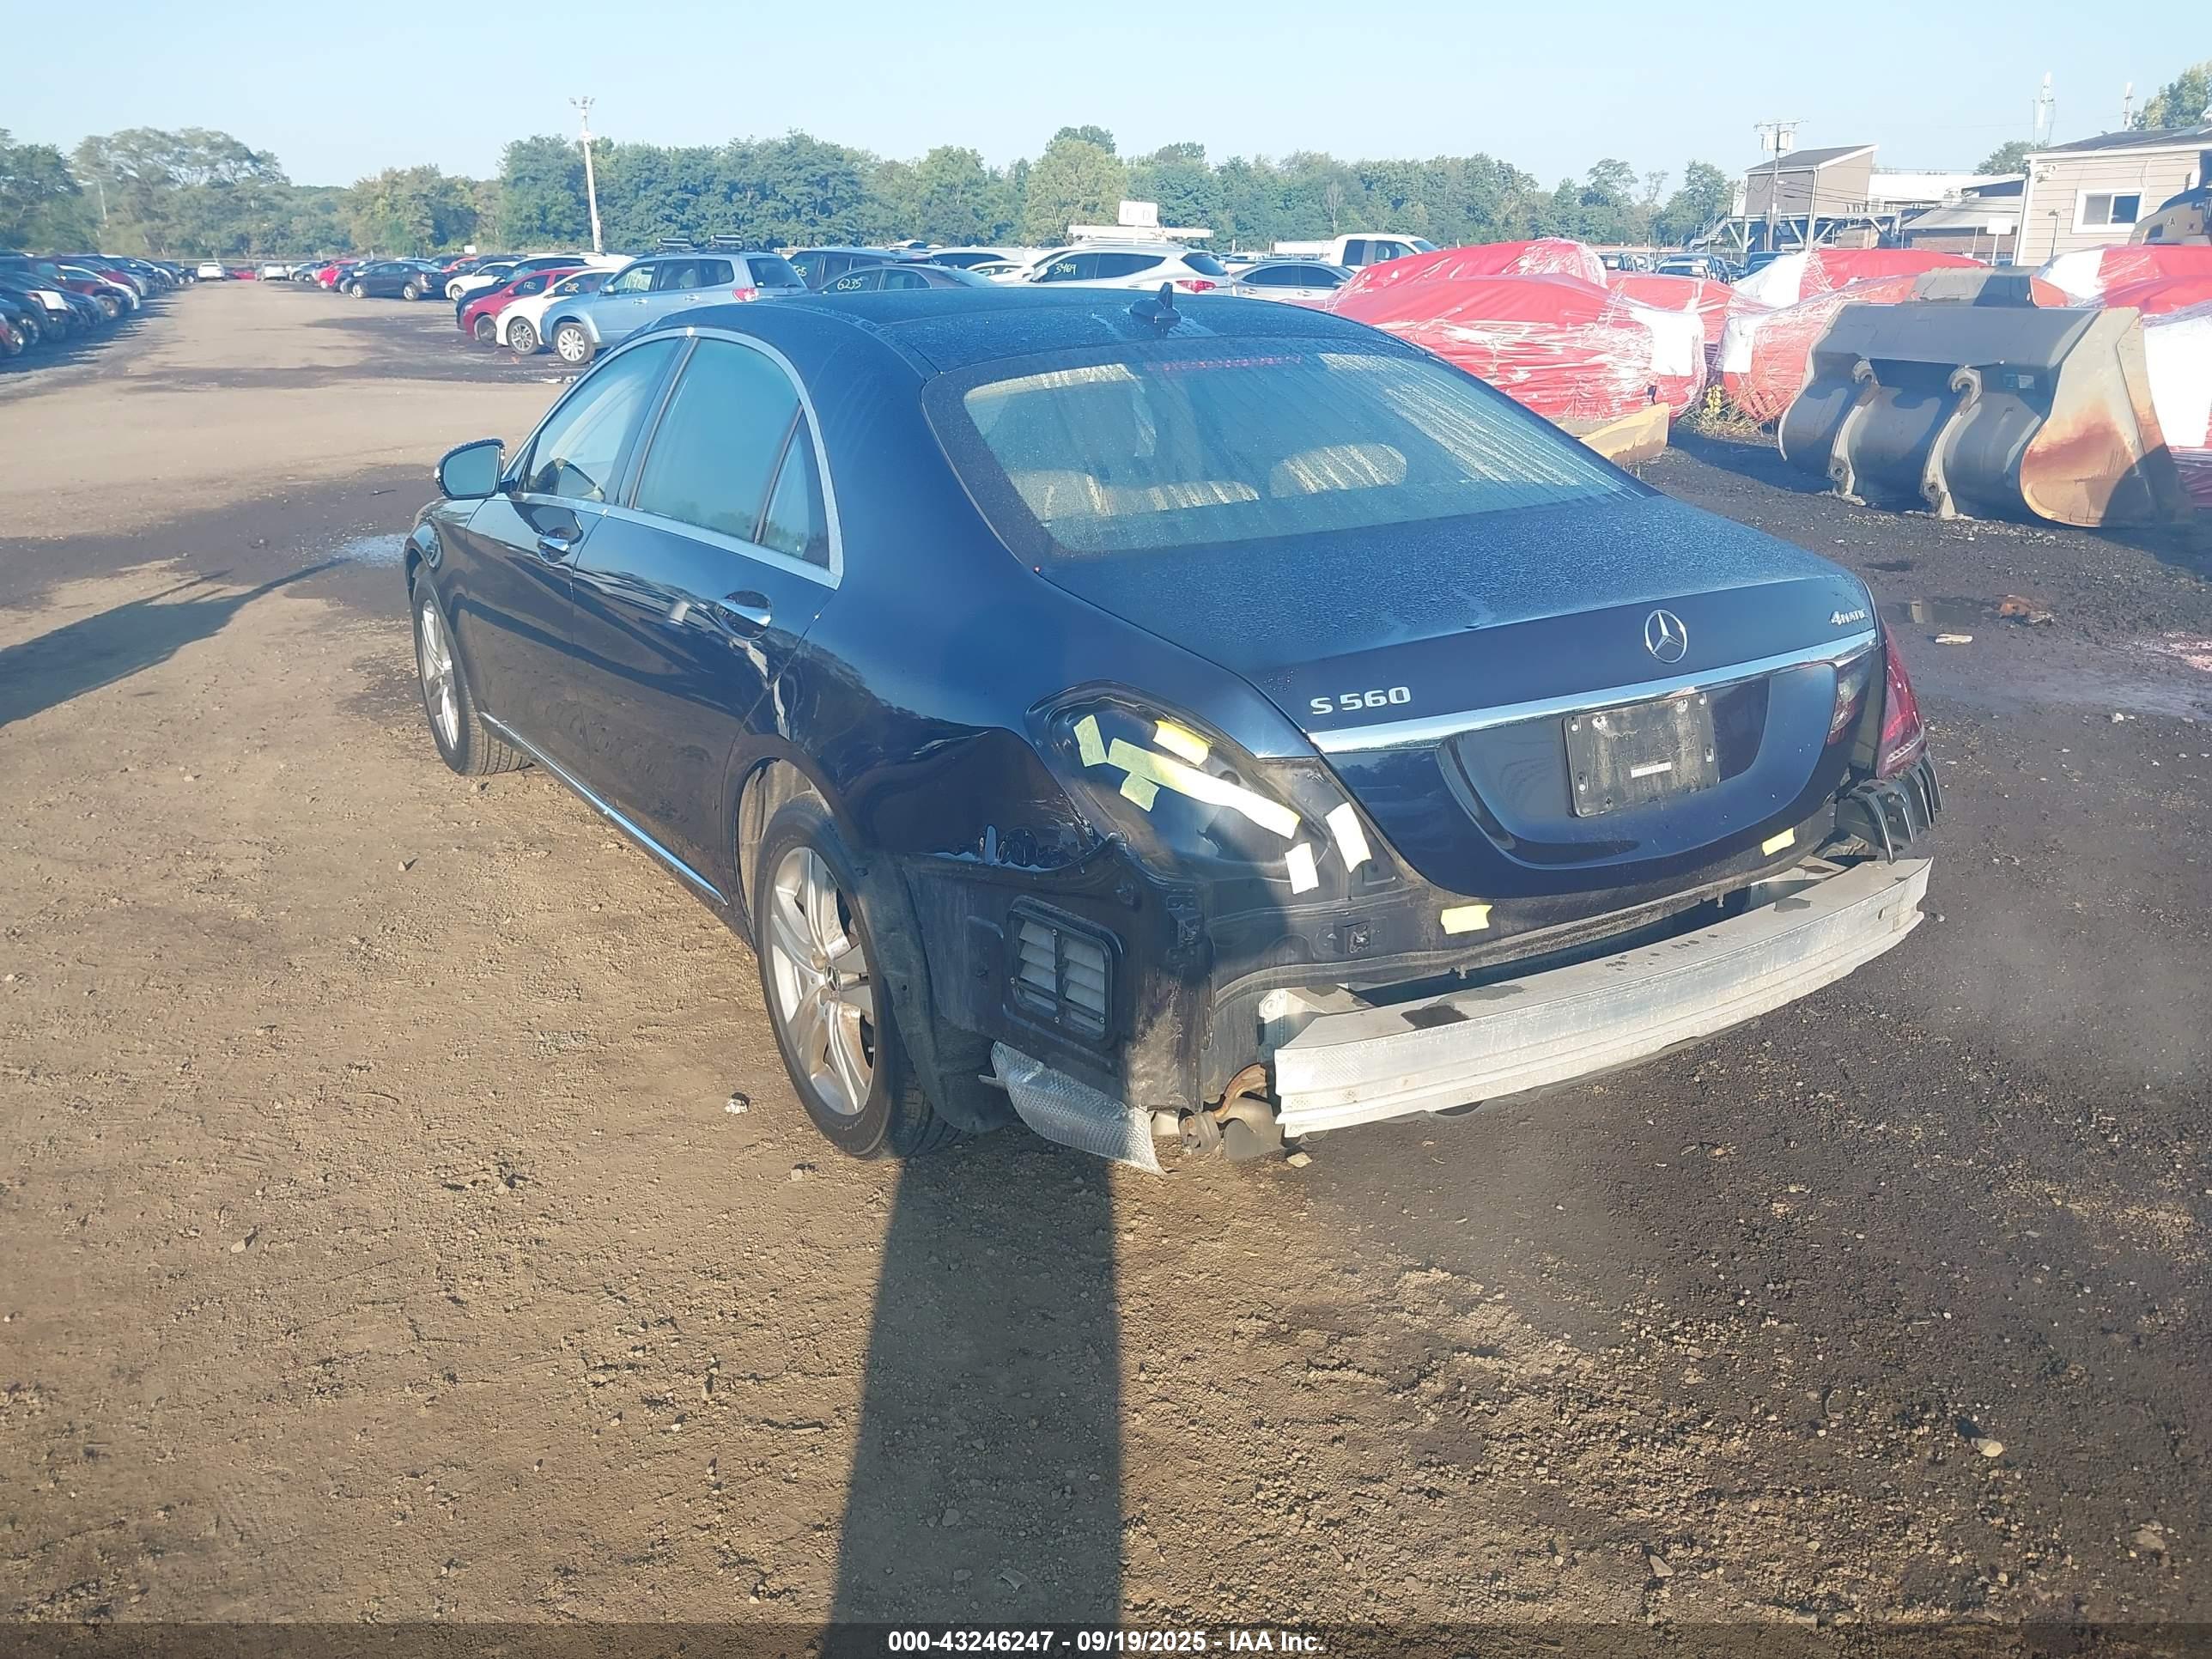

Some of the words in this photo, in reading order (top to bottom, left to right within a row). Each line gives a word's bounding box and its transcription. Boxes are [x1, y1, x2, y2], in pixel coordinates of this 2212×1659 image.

[1054, 264, 1078, 276] 3469
[836, 276, 863, 290] 6235
[1310, 696, 1334, 715] S
[1339, 686, 1412, 711] 560
